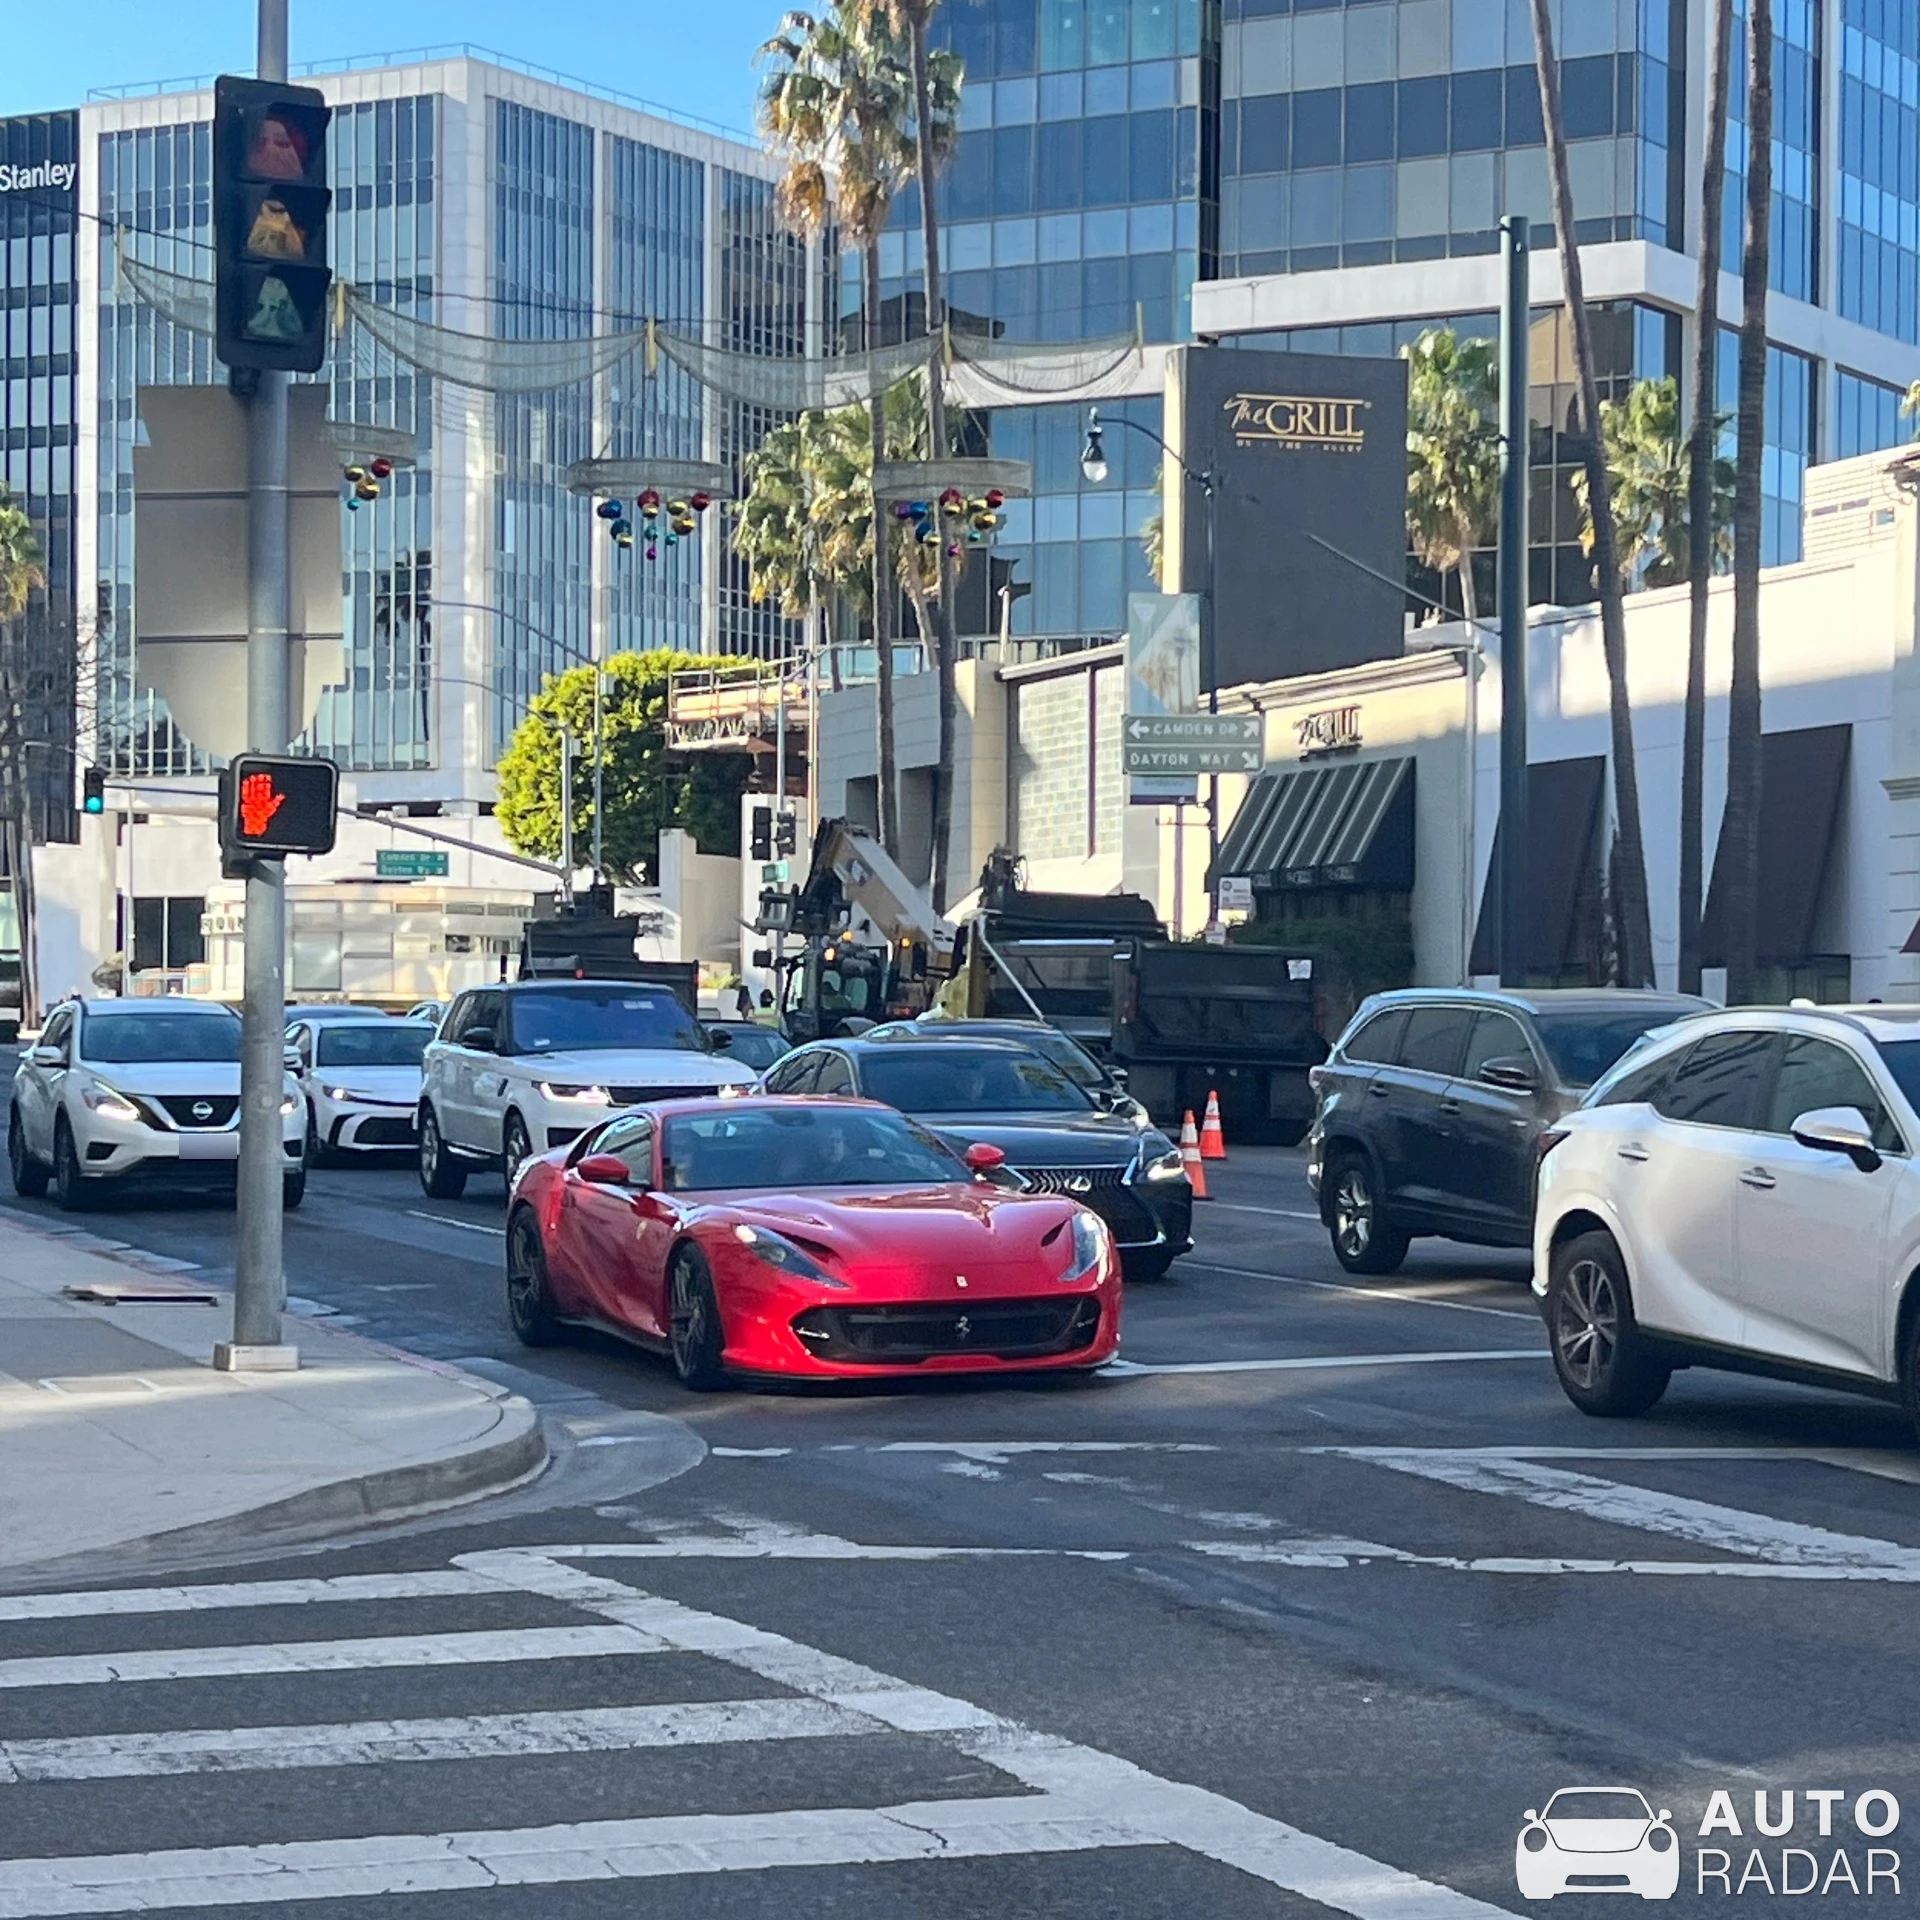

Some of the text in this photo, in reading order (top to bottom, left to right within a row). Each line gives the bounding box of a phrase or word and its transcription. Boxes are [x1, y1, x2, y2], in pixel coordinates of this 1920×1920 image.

[0, 159, 76, 191] Stanley
[1223, 398, 1365, 437] The GRILL
[1152, 722, 1239, 736] CAMDEN DR
[1129, 752, 1231, 766] DAYTON WAY
